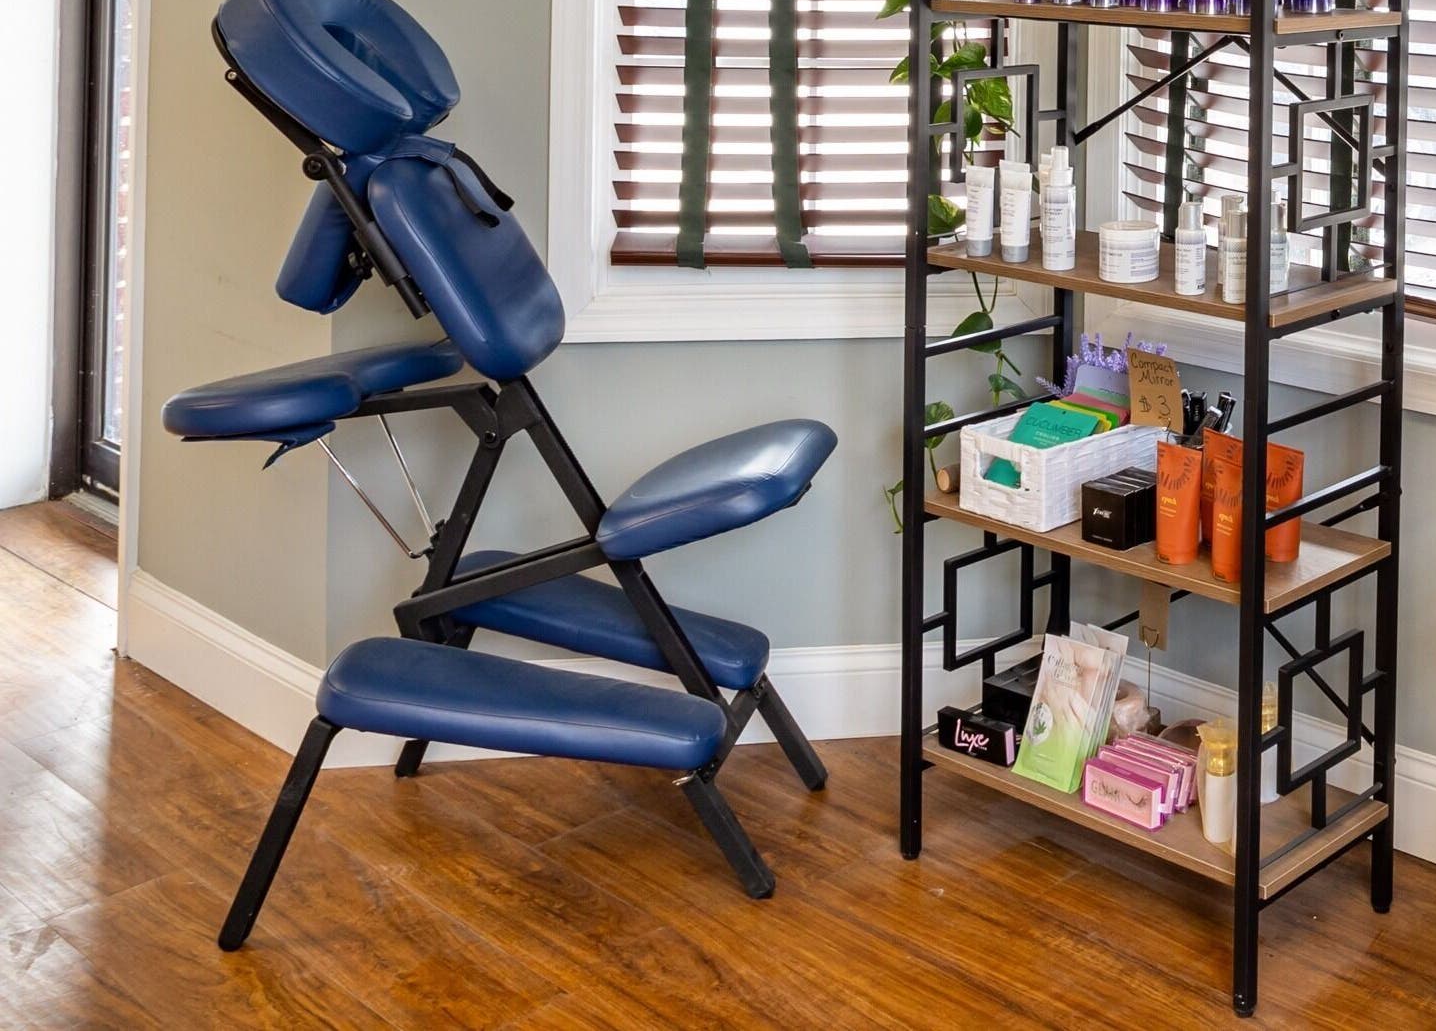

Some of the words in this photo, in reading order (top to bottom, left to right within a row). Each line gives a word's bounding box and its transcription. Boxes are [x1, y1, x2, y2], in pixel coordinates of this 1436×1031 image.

[1130, 352, 1174, 373] Compact
[1138, 371, 1174, 387] Mirror
[1025, 416, 1082, 437] CUCUMBER
